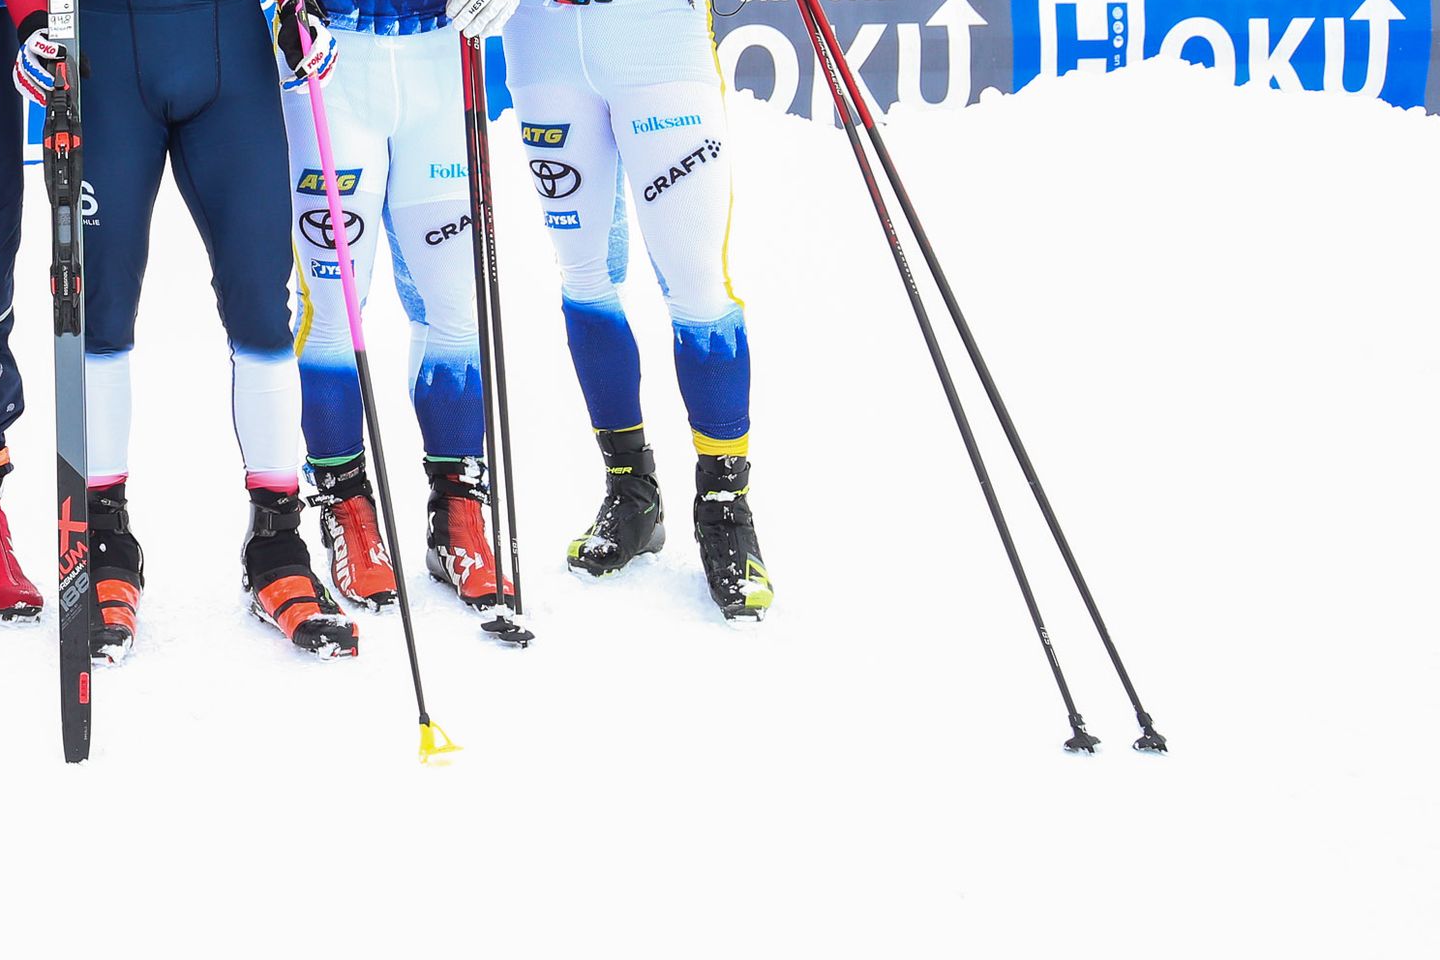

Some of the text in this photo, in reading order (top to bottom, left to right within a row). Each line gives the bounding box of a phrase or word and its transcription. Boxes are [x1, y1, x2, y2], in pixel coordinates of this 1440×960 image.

[632, 113, 702, 135] Folksam
[522, 127, 563, 144] ATG
[644, 148, 706, 202] CRAFT
[548, 213, 578, 226] JYSK
